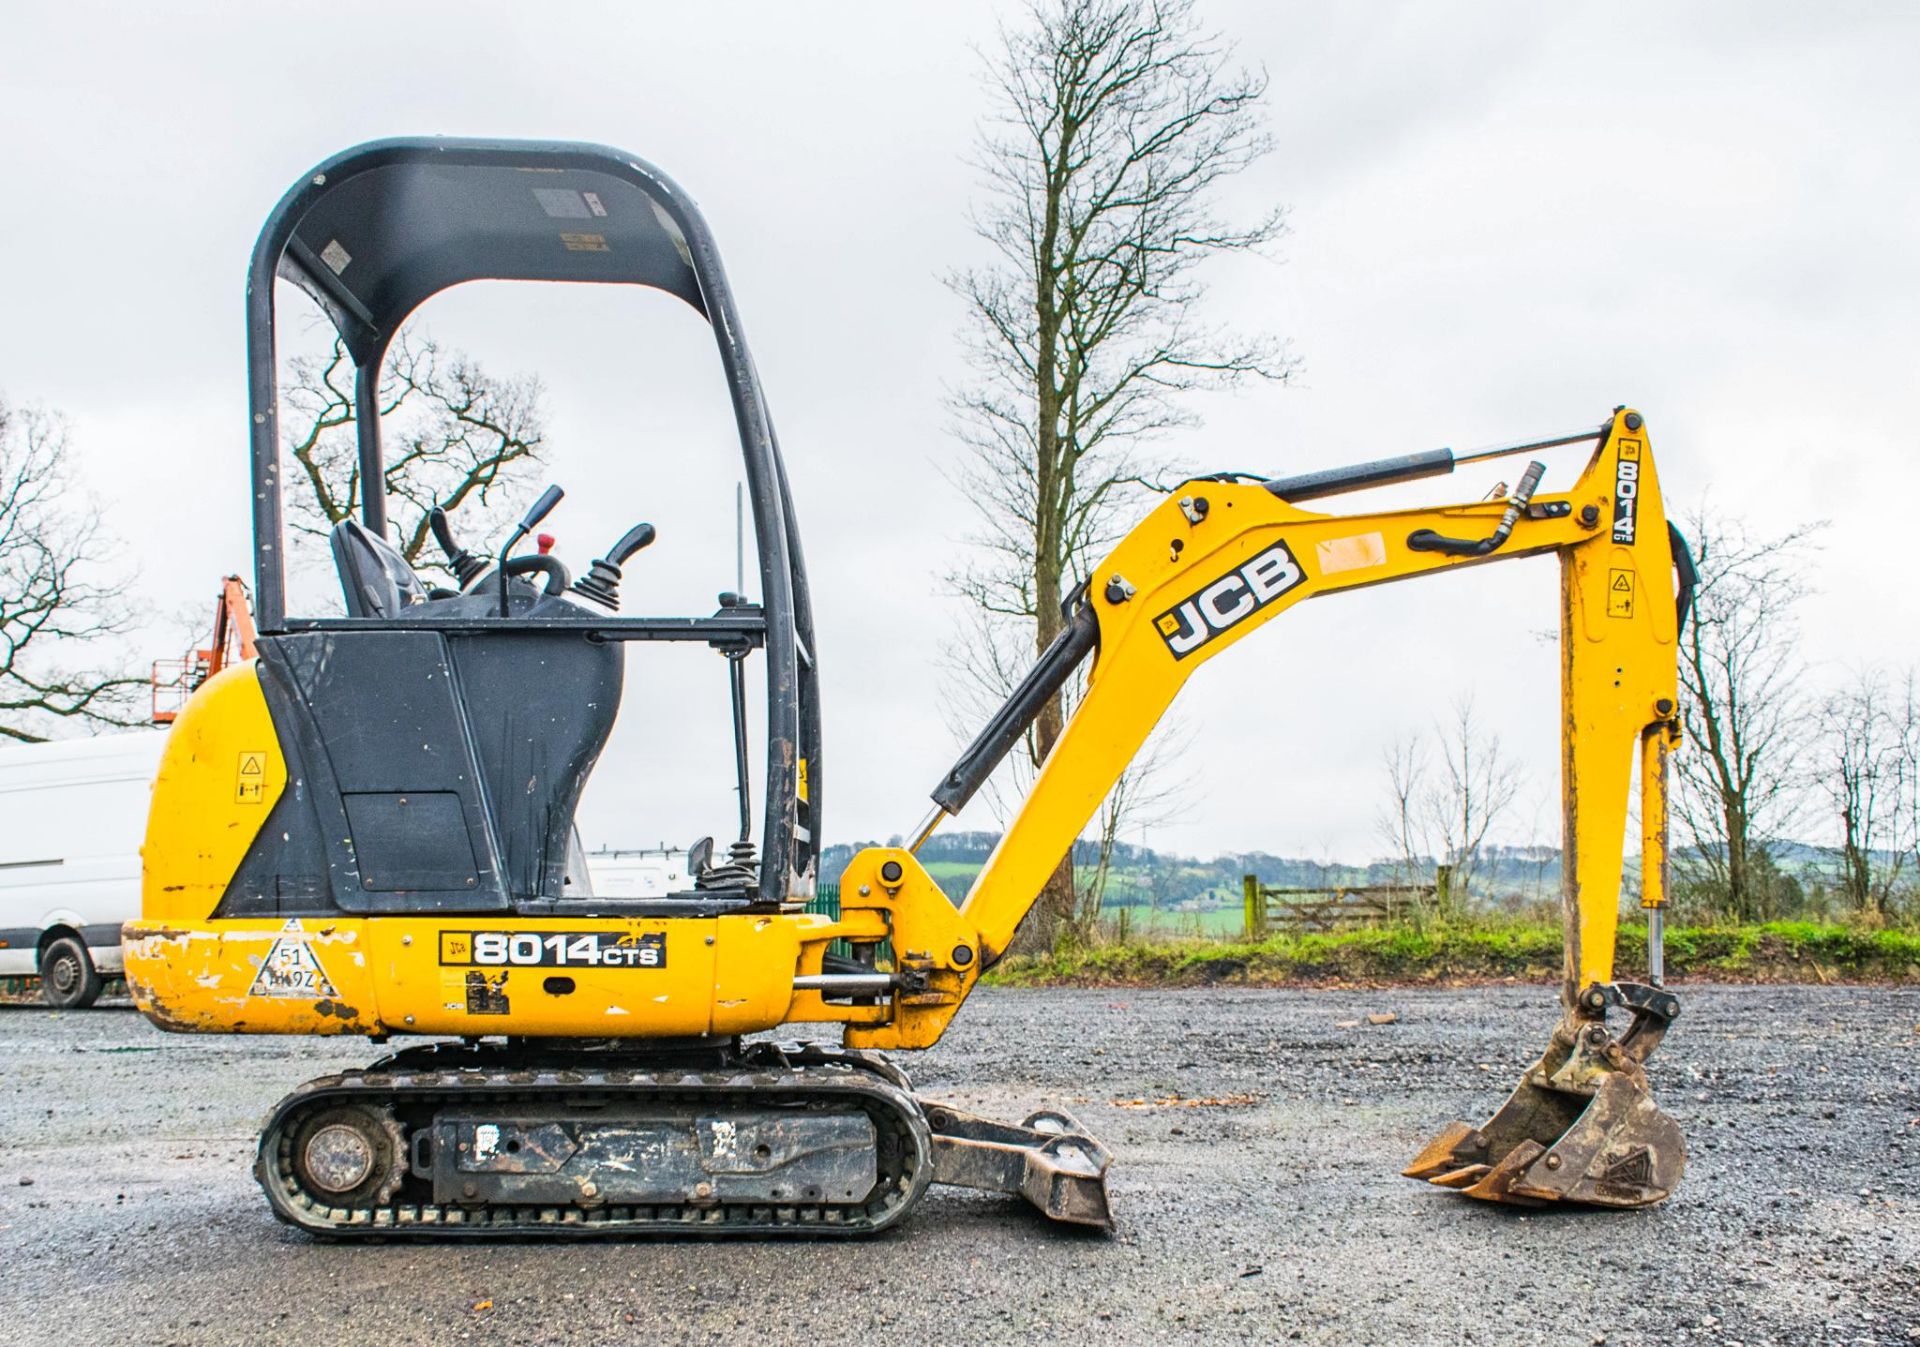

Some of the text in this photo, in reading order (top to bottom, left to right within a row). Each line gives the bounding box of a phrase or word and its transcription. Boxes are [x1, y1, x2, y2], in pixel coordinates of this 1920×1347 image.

[1613, 461, 1638, 535] 8014
[1168, 547, 1300, 653] JCB
[281, 948, 301, 966] 51
[474, 933, 602, 965] 8014
[602, 948, 659, 965] CTS
